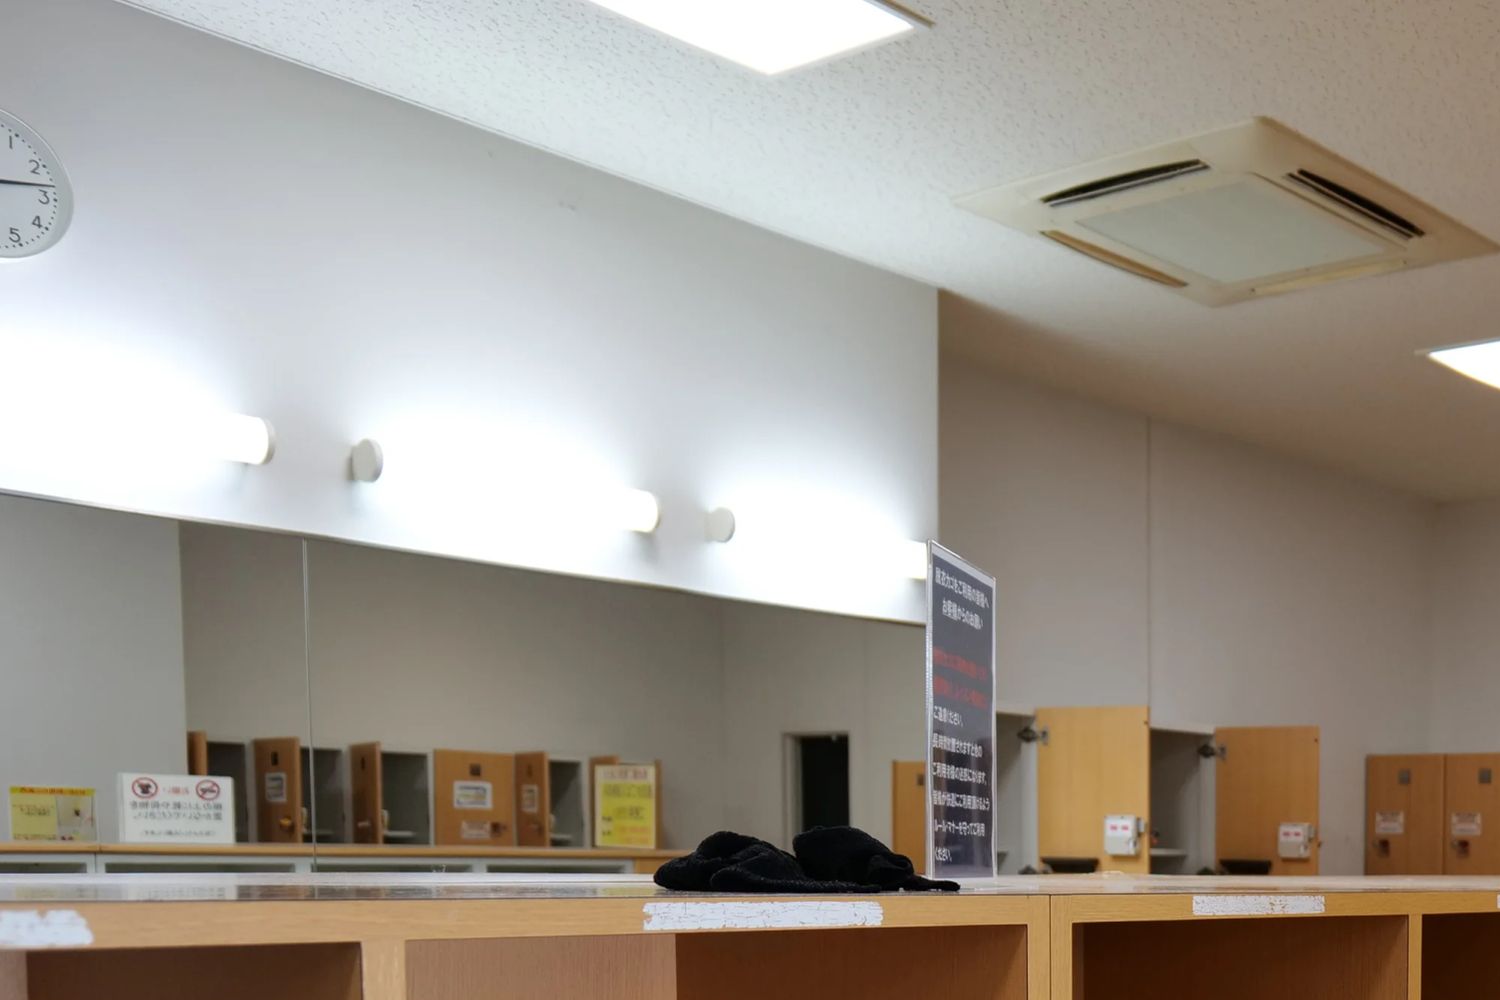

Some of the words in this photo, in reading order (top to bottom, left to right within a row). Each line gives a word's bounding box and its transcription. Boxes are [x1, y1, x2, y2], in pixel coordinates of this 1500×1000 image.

[28, 159, 41, 175] 2
[38, 189, 50, 205] 3
[31, 215, 43, 229] 4
[9, 227, 21, 243] 5
